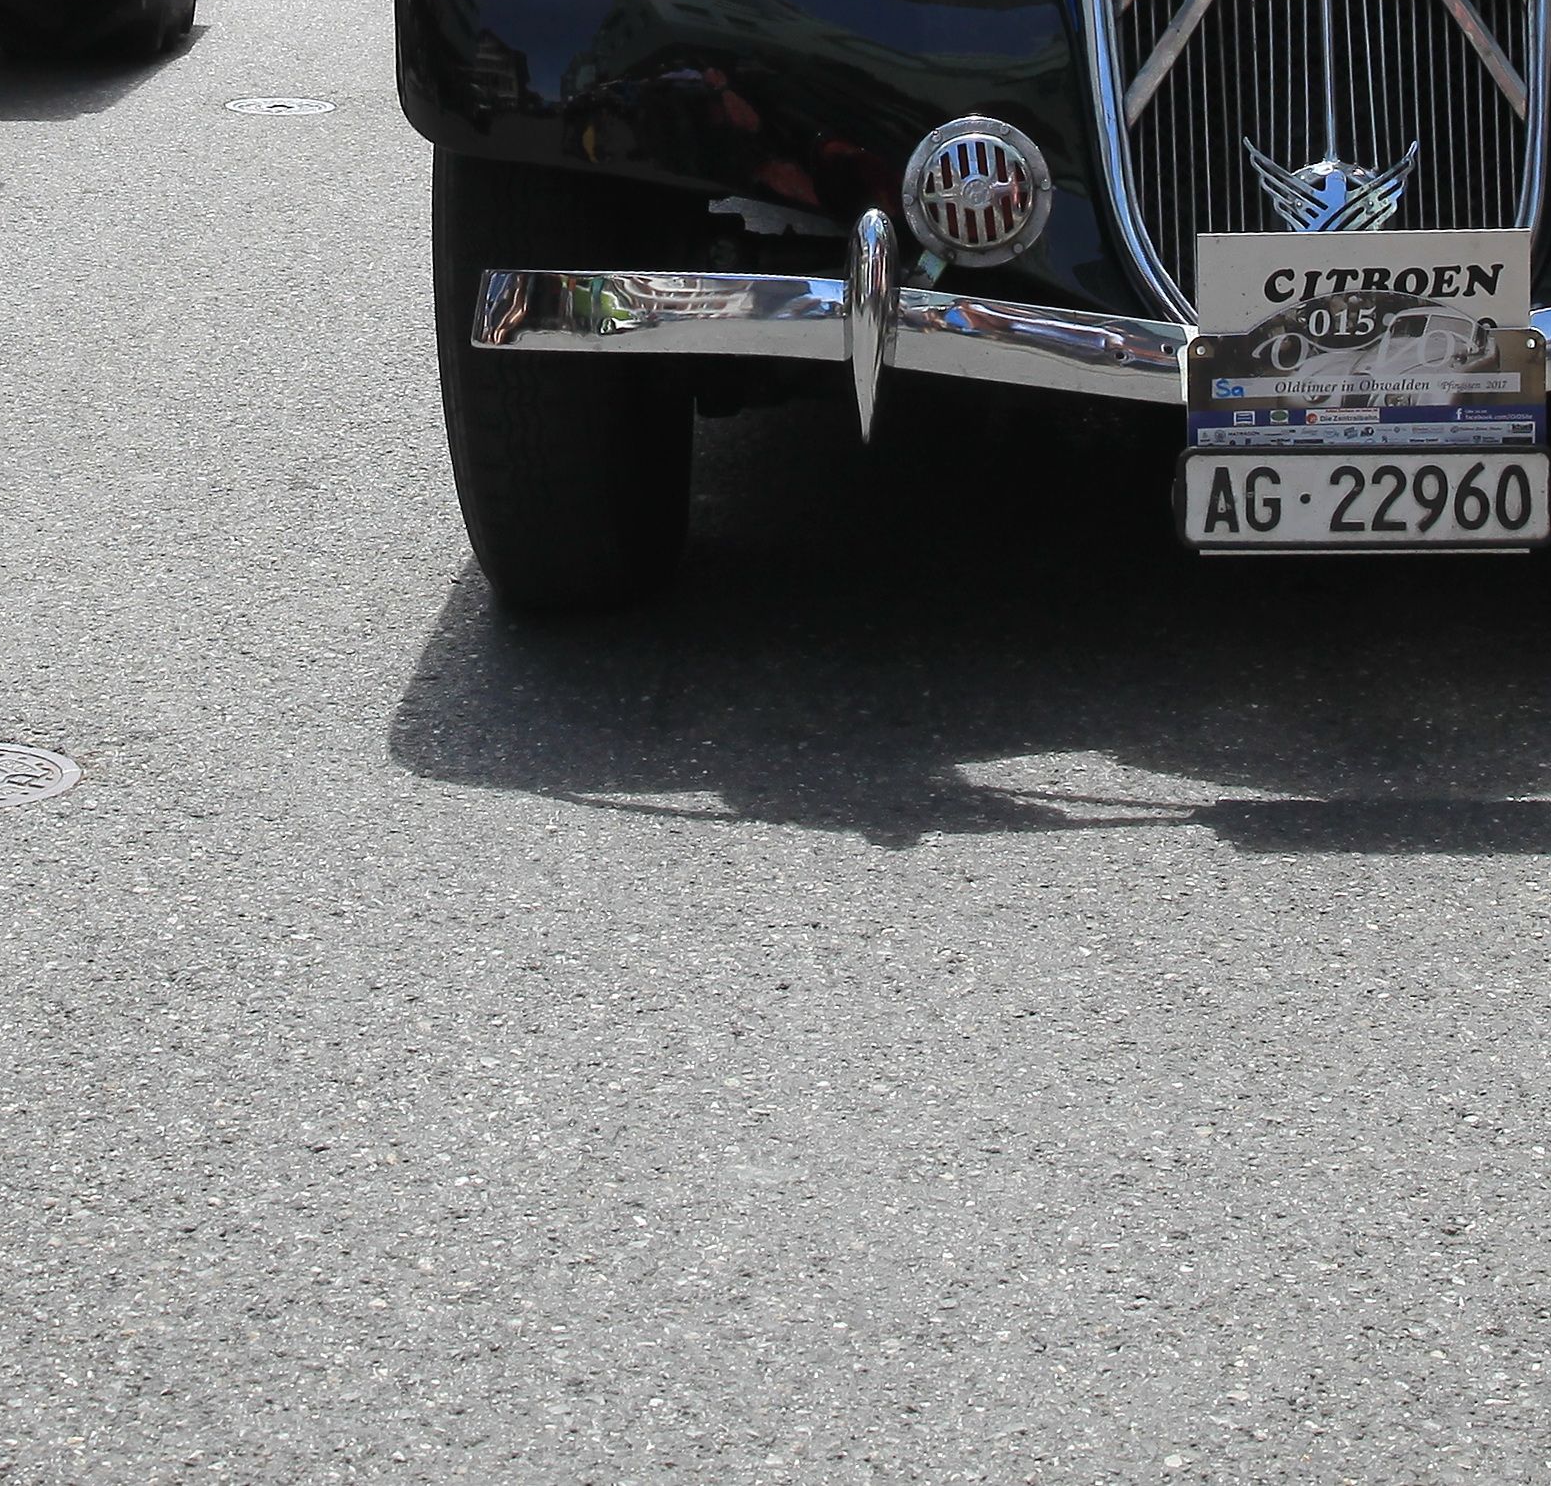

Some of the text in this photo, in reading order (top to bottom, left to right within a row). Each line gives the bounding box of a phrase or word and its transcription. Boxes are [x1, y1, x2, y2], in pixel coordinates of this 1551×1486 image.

[1264, 264, 1504, 302] CITROEN
[1309, 305, 1378, 336] 015
[1215, 378, 1245, 398] Sa
[1274, 381, 1337, 394] Oldtimer
[1341, 380, 1354, 392] in
[1359, 379, 1430, 392] Obwalden
[1485, 380, 1508, 390] 2017
